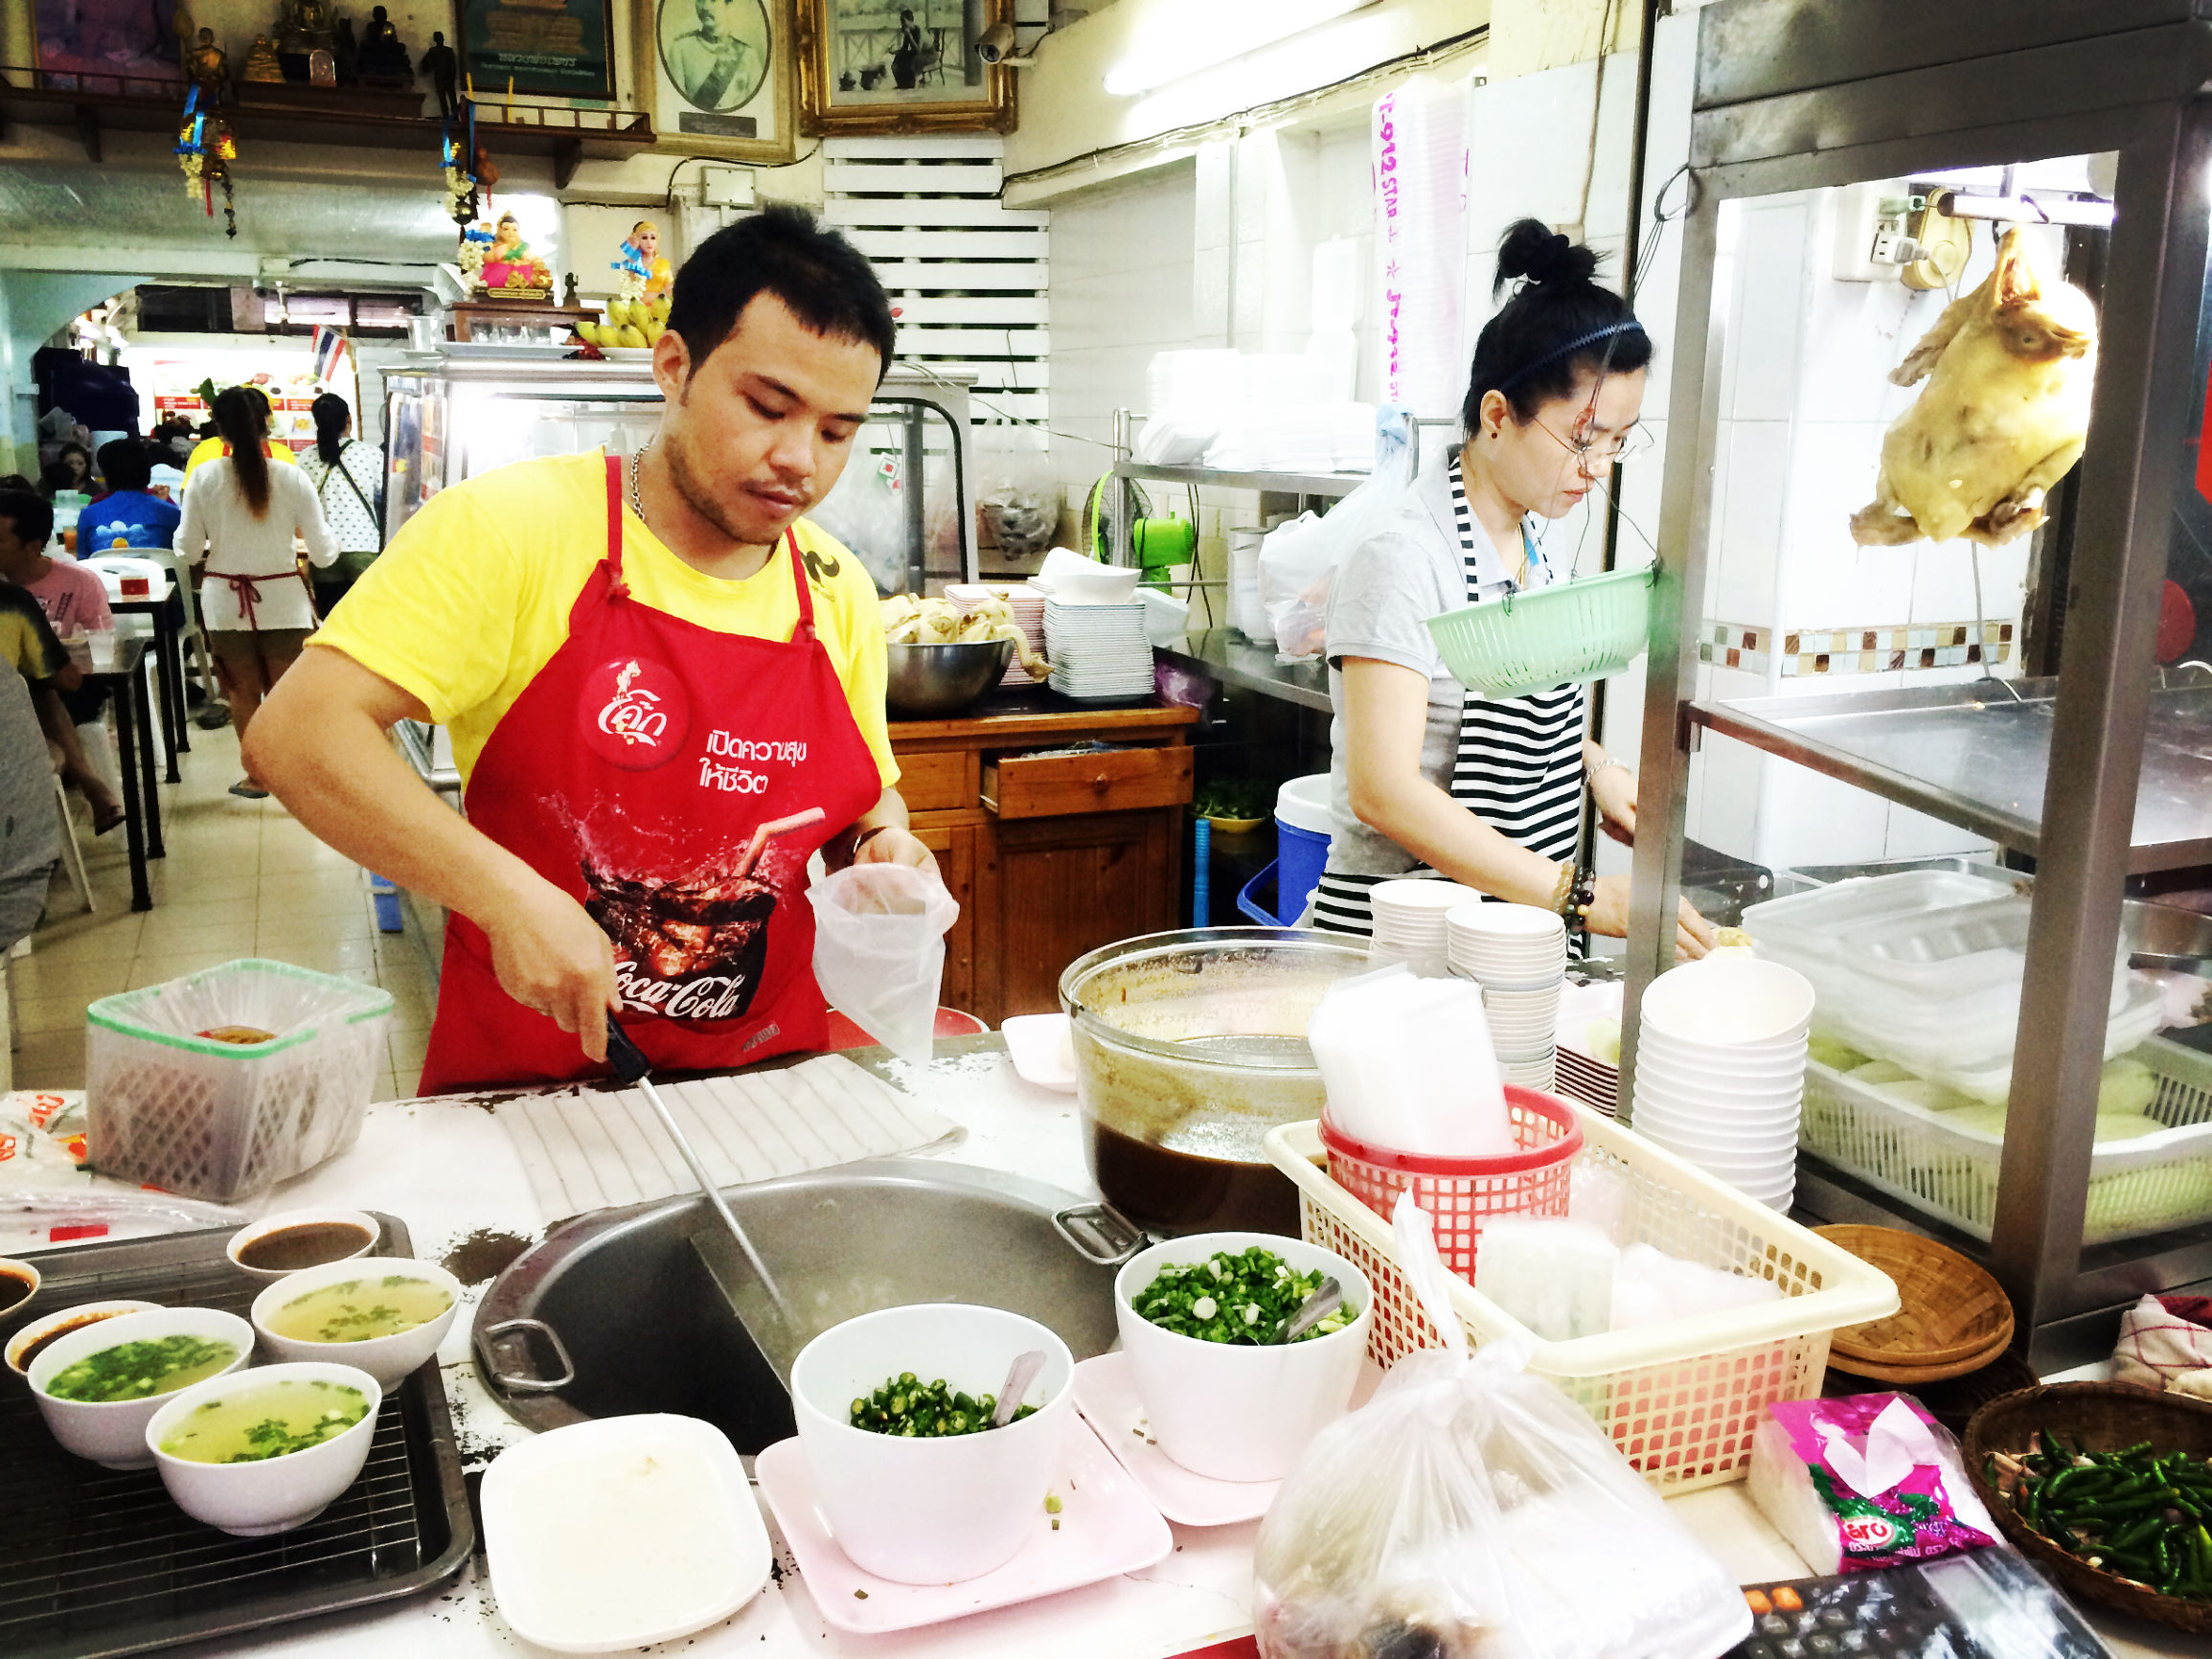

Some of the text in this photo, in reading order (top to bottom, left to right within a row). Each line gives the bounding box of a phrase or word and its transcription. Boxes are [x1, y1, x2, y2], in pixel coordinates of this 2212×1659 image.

[1381, 177, 1399, 219] STAR
[698, 757, 769, 794] ให้ชีวิต
